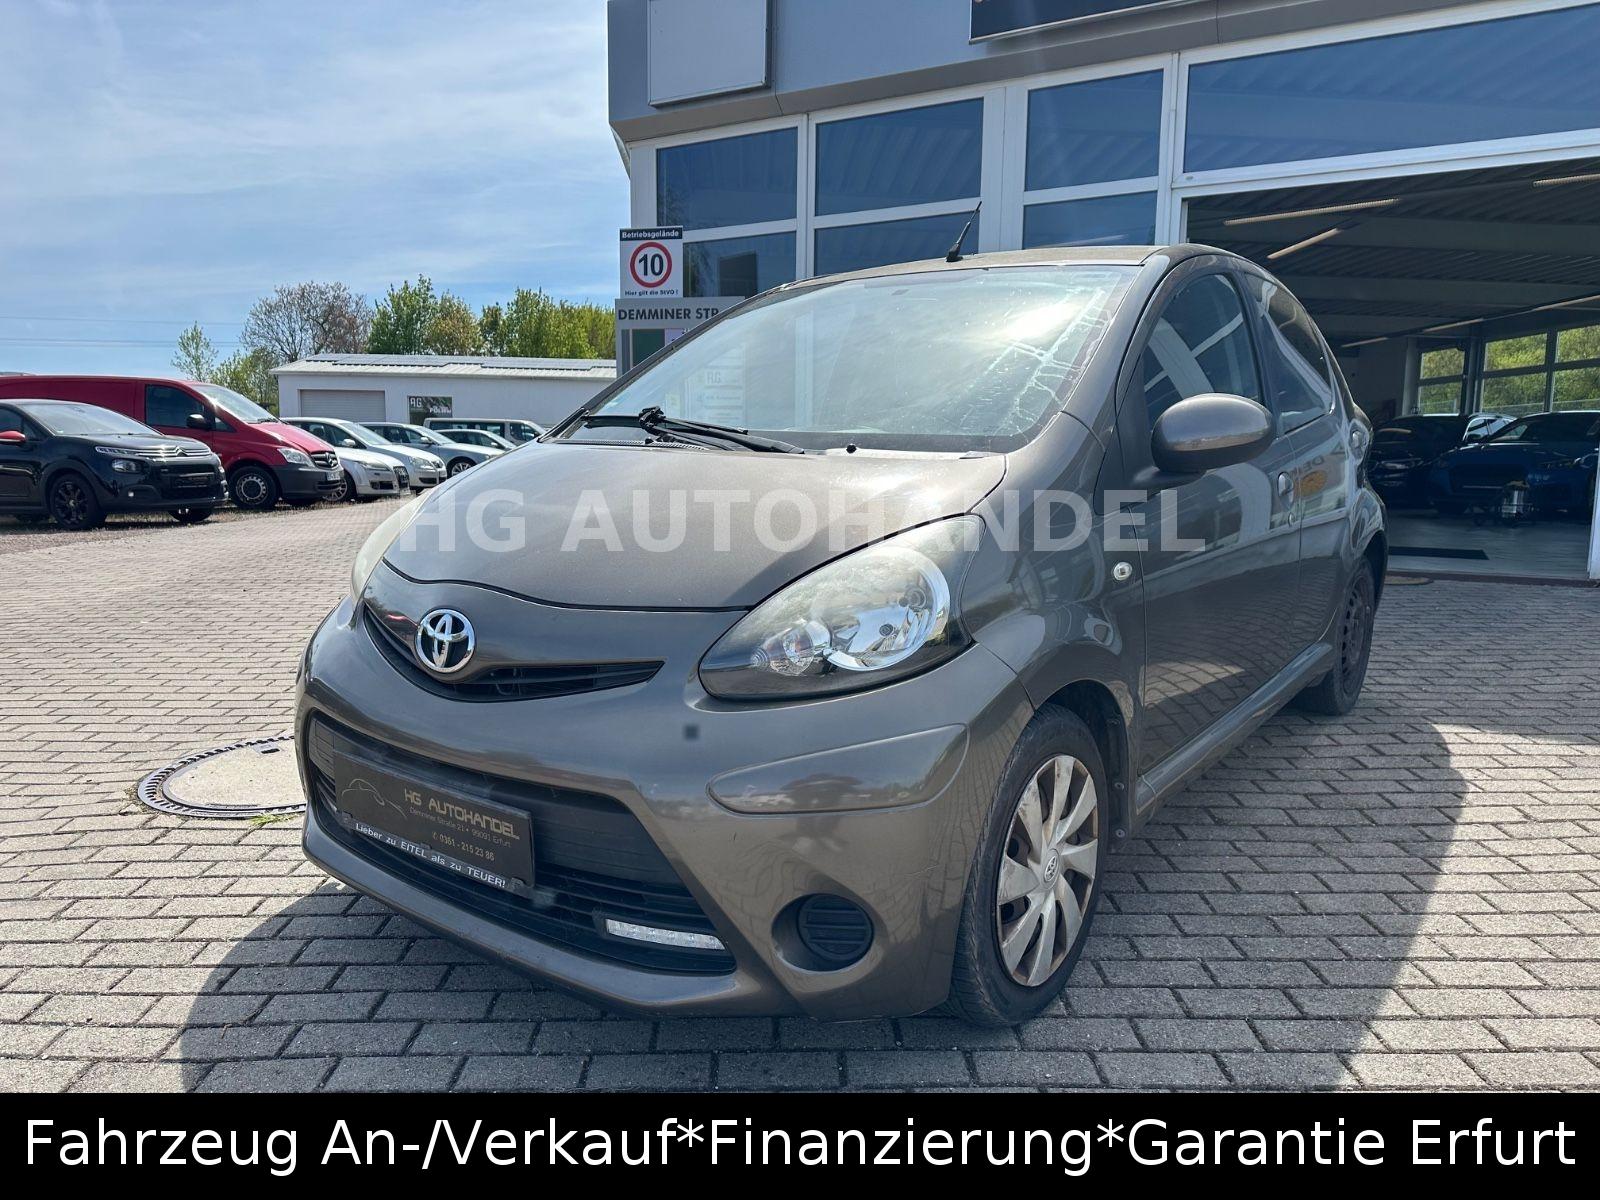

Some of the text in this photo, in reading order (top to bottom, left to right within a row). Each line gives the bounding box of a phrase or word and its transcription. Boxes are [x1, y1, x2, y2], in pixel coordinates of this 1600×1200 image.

[621, 229, 680, 240] Betriebsgelände
[638, 253, 664, 277] 10
[618, 308, 691, 320] DEMMINER
[404, 788, 520, 840] HG AUTOHANDEL
[355, 822, 506, 888] Lieber zu EITEL als zu TEUER!
